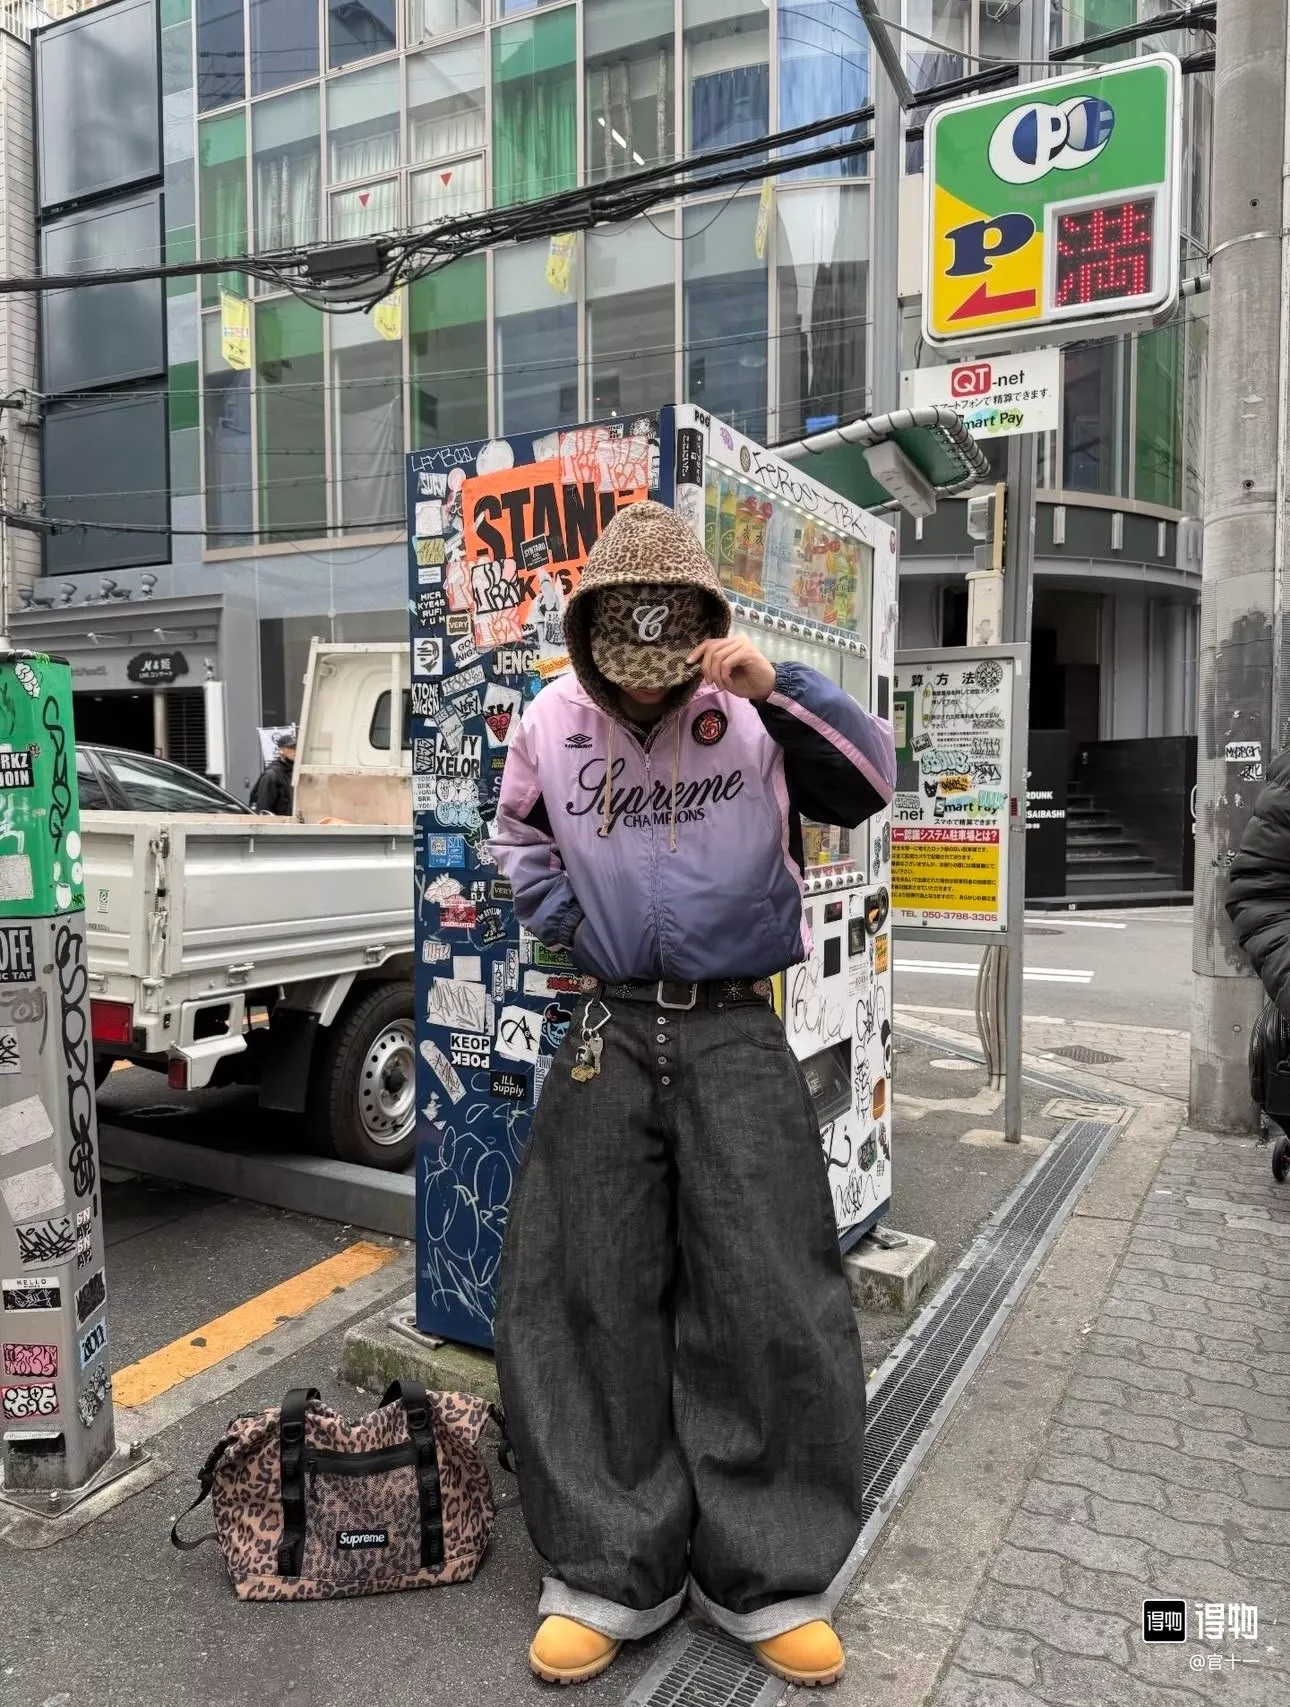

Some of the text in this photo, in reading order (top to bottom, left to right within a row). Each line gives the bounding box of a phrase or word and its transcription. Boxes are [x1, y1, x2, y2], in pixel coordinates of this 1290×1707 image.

[945, 213, 1035, 277] P
[957, 411, 1024, 430] mart Pay
[449, 620, 469, 629] VERY
[435, 756, 480, 779] XELOR
[566, 757, 744, 838] Supreme
[623, 808, 705, 828] CHAMPIONS
[494, 887, 513, 895] VERY
[901, 910, 917, 918] TEL
[12, 971, 33, 980] TAF
[451, 1035, 490, 1051] KEOP
[501, 1075, 514, 1086] ILL
[493, 1081, 525, 1097] Supply.
[17, 1278, 47, 1286] HELLO
[339, 1532, 385, 1547] Supreme
